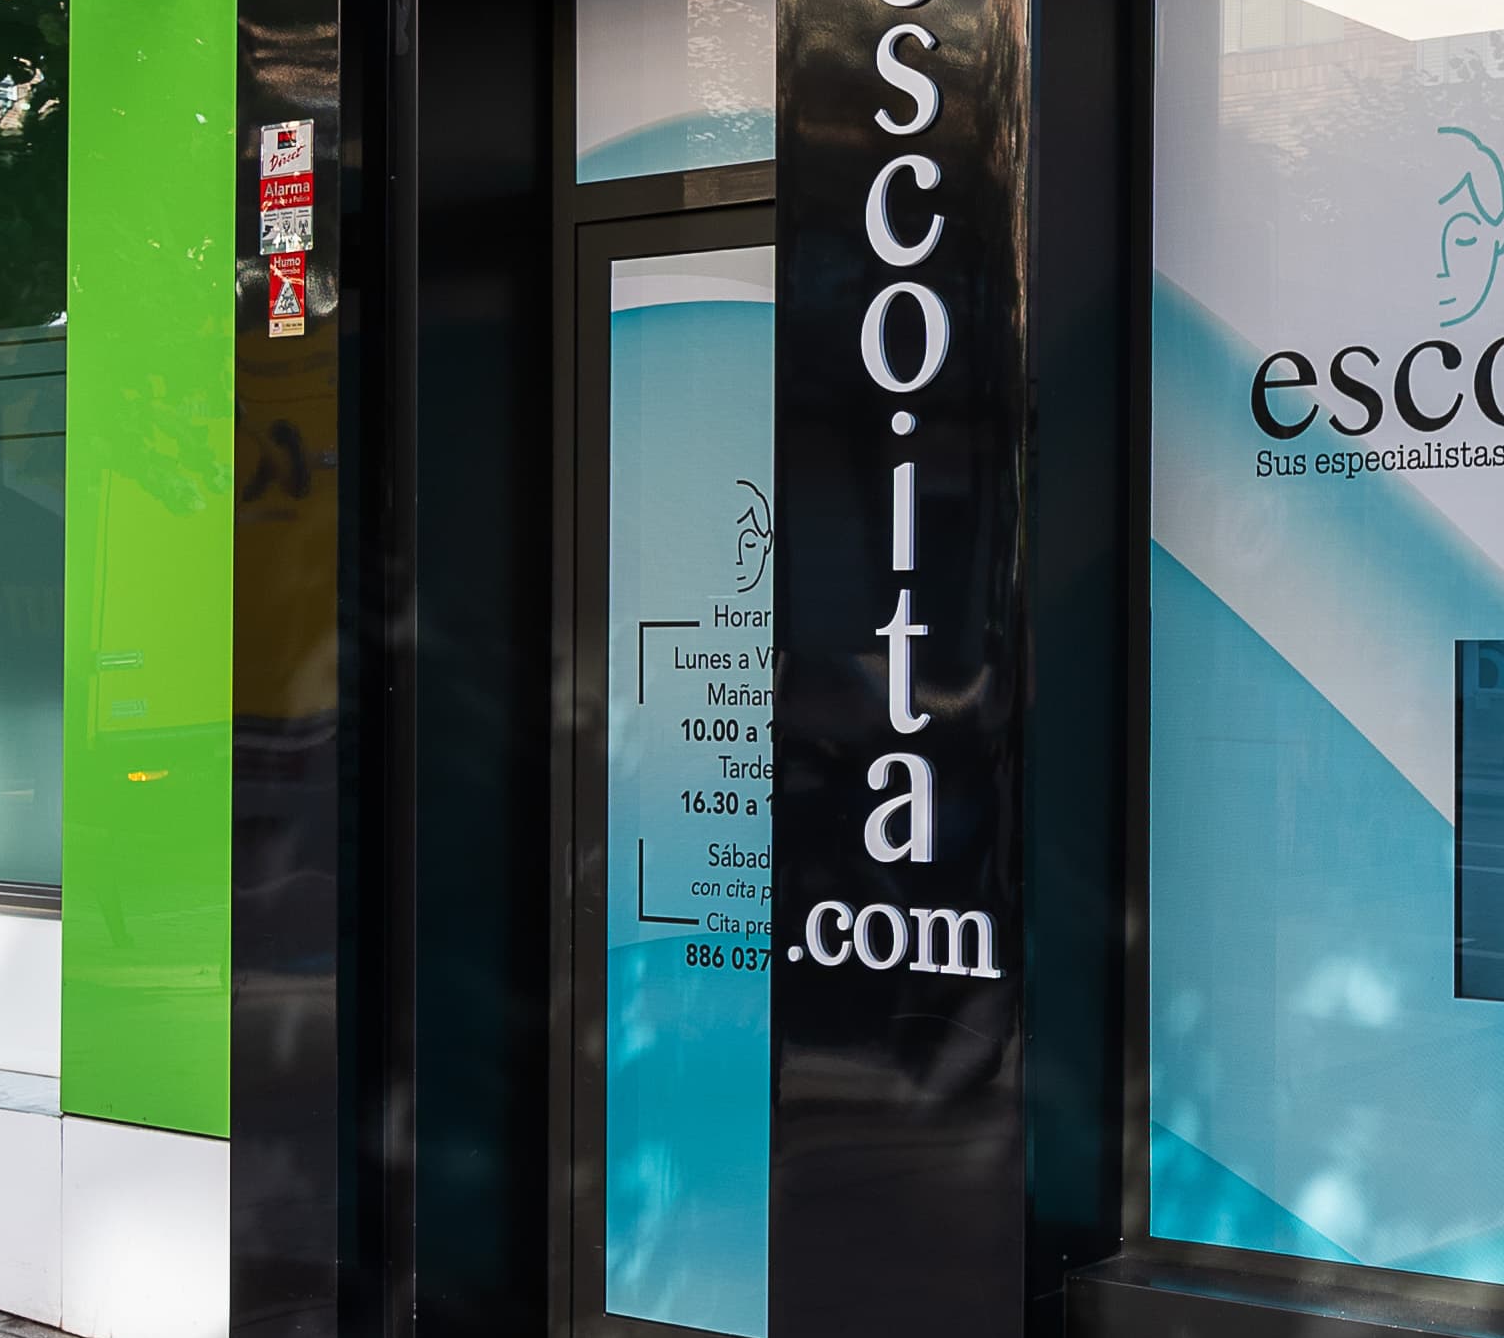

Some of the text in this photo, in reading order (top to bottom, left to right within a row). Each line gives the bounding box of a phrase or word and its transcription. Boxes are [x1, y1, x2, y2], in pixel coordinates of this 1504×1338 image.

[264, 180, 310, 198] Alarma
[273, 255, 301, 268] Humo
[1255, 449, 1308, 478] Sus
[674, 646, 732, 670] Lunes
[738, 652, 750, 670] a
[681, 718, 739, 743] 10.00
[746, 726, 758, 743] a
[681, 790, 739, 815] 16.30
[746, 798, 758, 816] a
[691, 881, 721, 897] con
[726, 878, 756, 899] cita
[706, 912, 740, 934] Cita
[787, 900, 1004, 980] .com
[685, 943, 772, 972] 886 037
